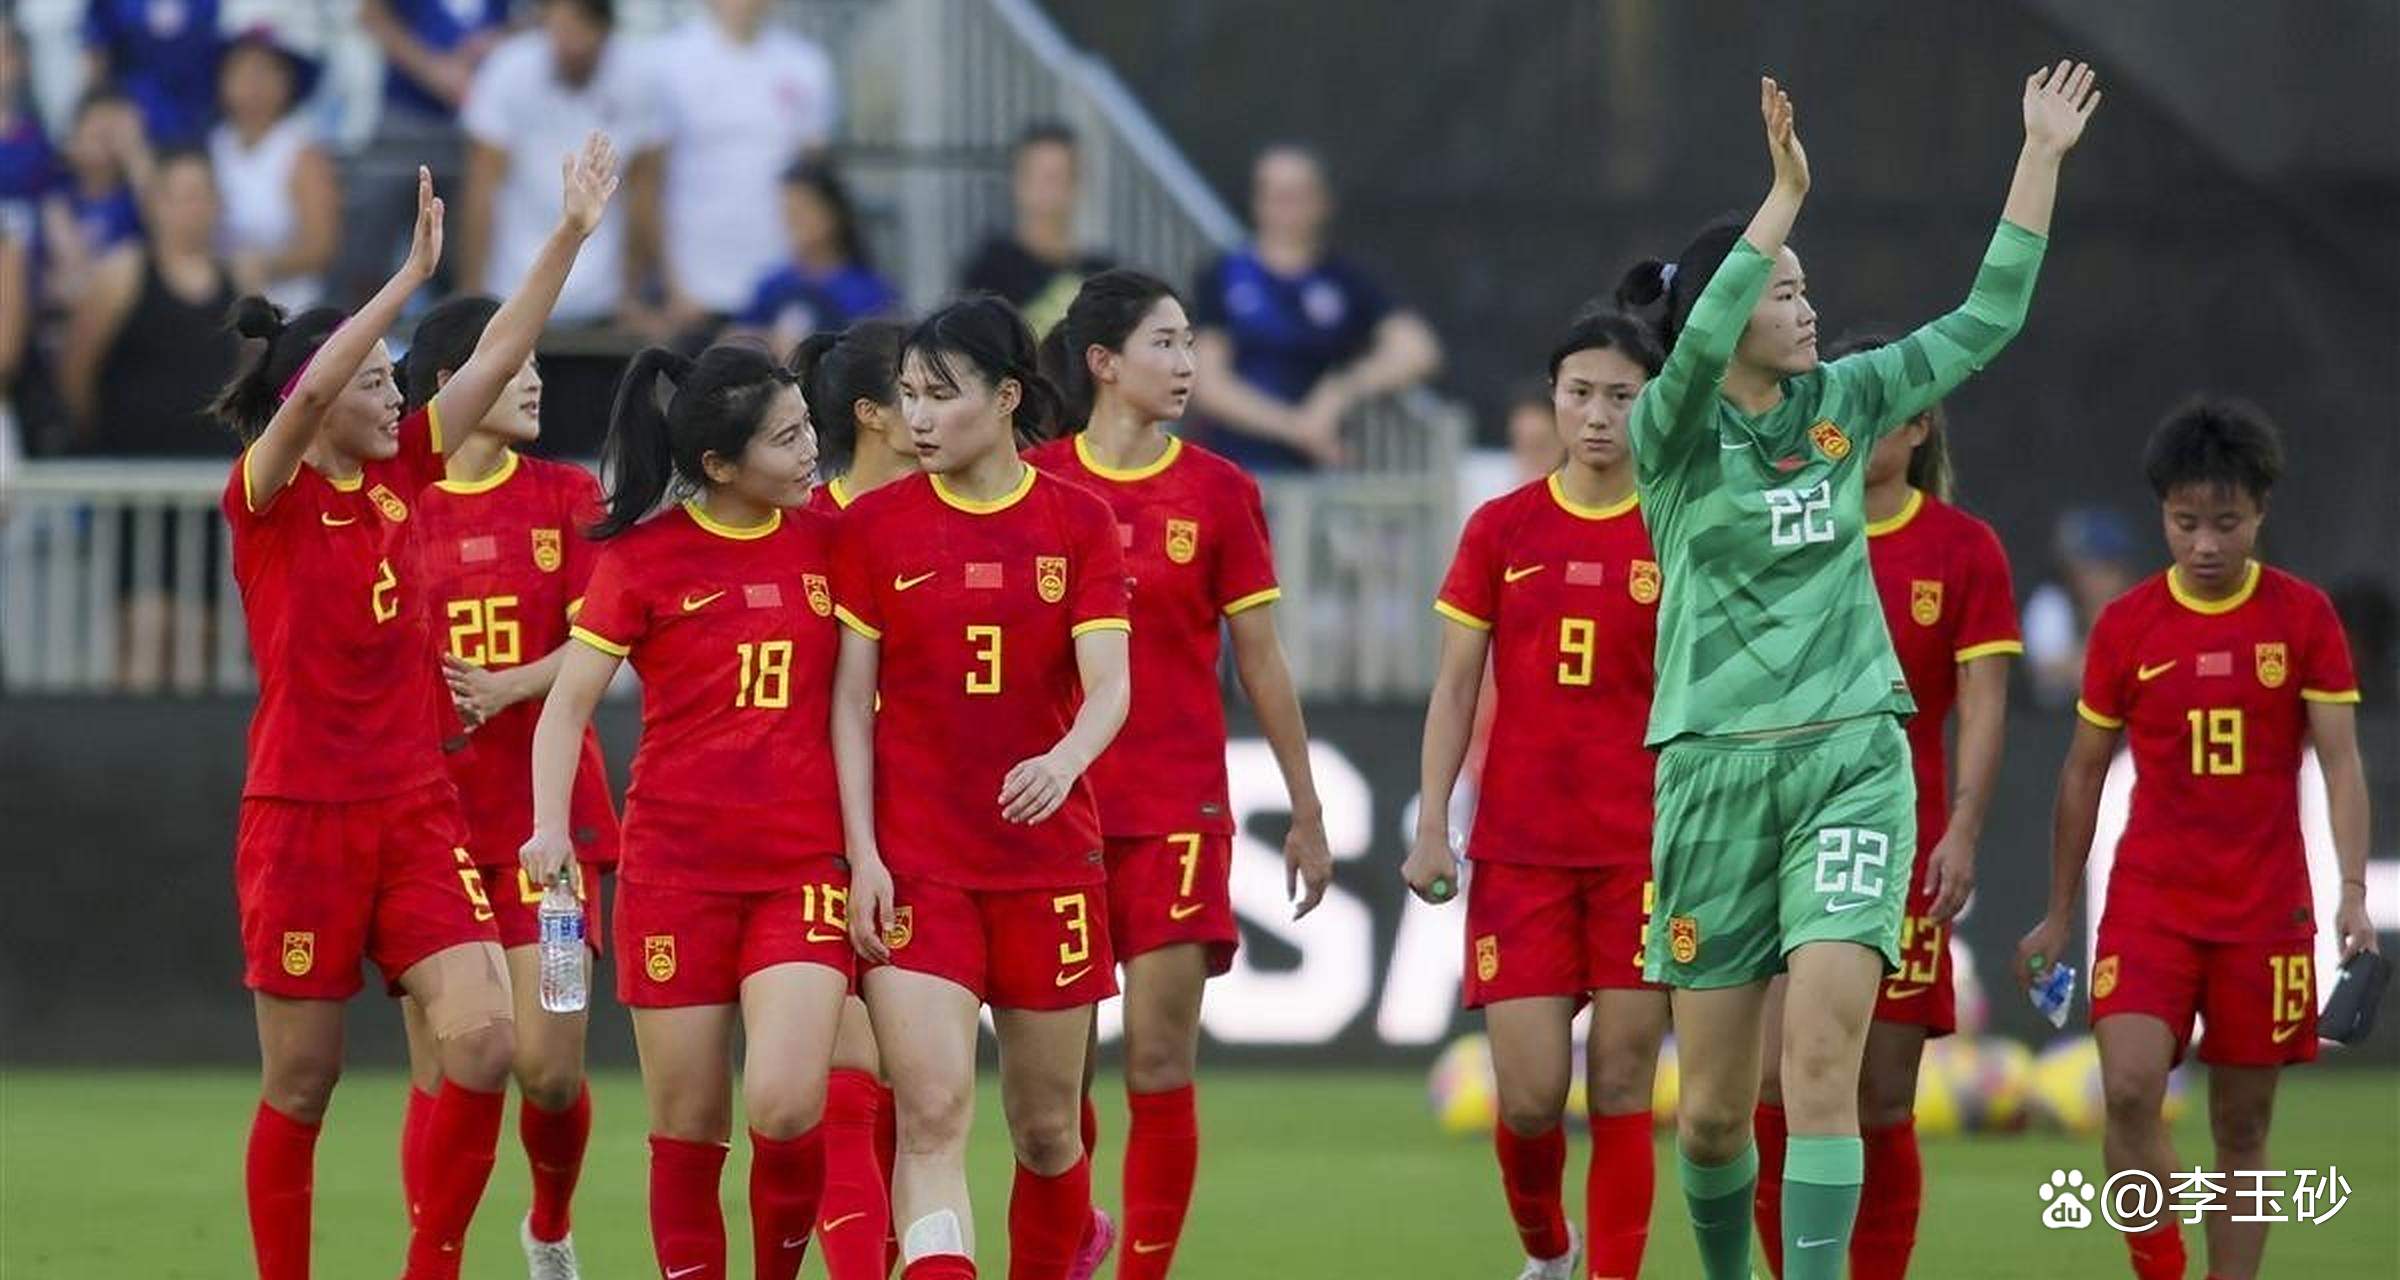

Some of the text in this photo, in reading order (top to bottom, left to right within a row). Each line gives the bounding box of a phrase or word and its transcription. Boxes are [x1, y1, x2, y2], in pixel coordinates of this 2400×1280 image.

[1763, 479, 1835, 546] 22
[372, 558, 398, 624] 2
[447, 595, 521, 666] 26
[966, 625, 1001, 694] 3
[1557, 617, 1595, 686] 9
[735, 640, 793, 708] 18
[2187, 709, 2243, 775] 19
[1167, 832, 1200, 897] 7
[1815, 828, 1889, 898] 22
[1053, 893, 1089, 964] 3
[2270, 956, 2310, 1022] 19
